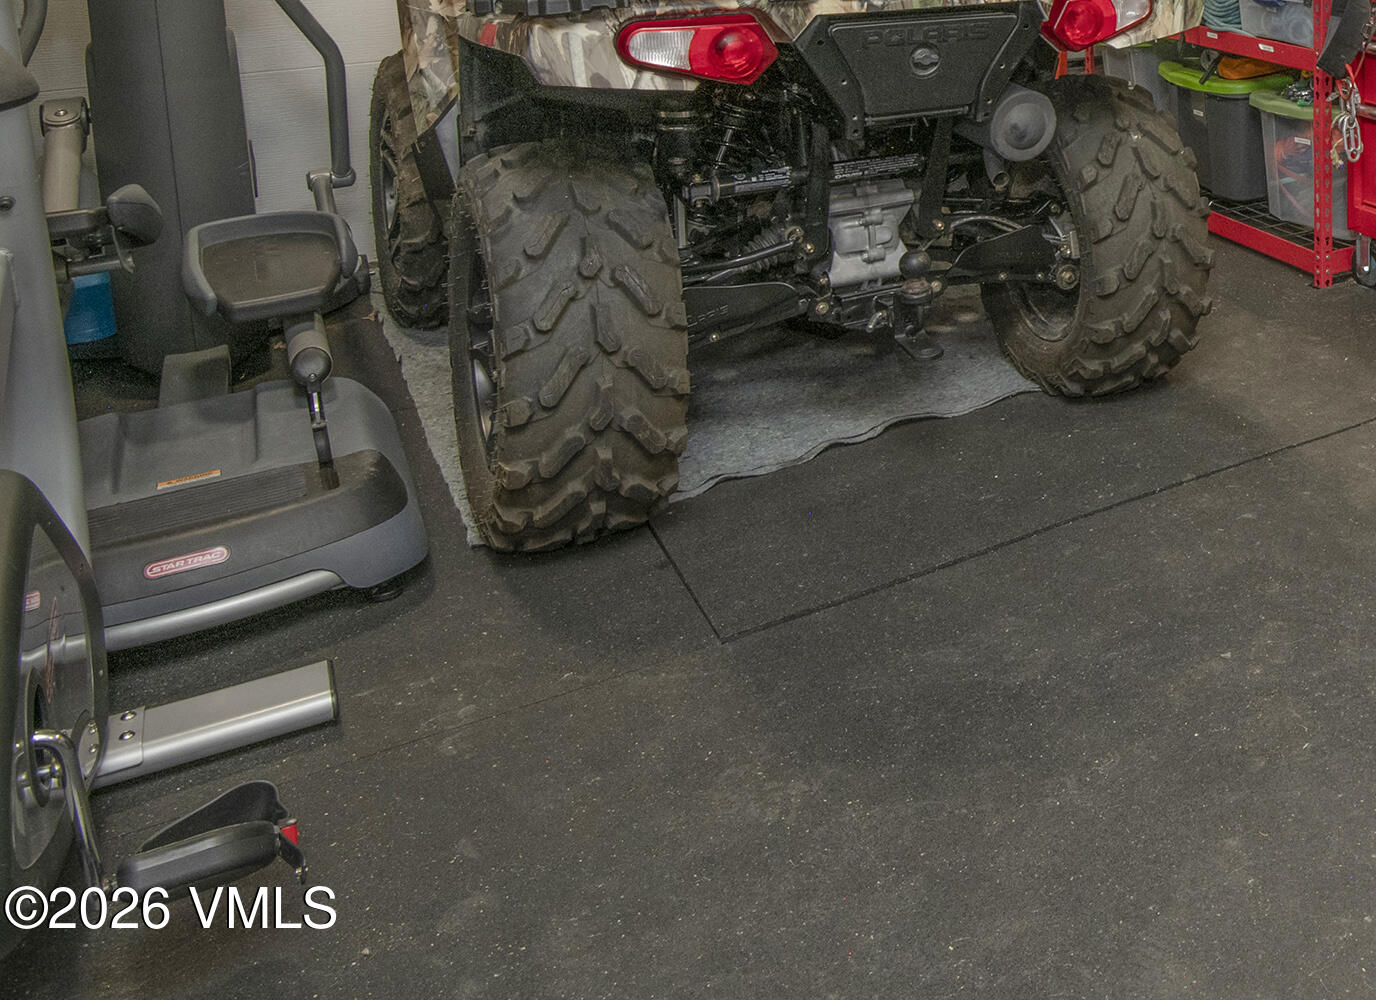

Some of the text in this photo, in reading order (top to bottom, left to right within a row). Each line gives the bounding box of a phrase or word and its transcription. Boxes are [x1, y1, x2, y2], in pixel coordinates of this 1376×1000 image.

[861, 22, 991, 46] POLARIS
[151, 551, 221, 574] STAR TRAC
